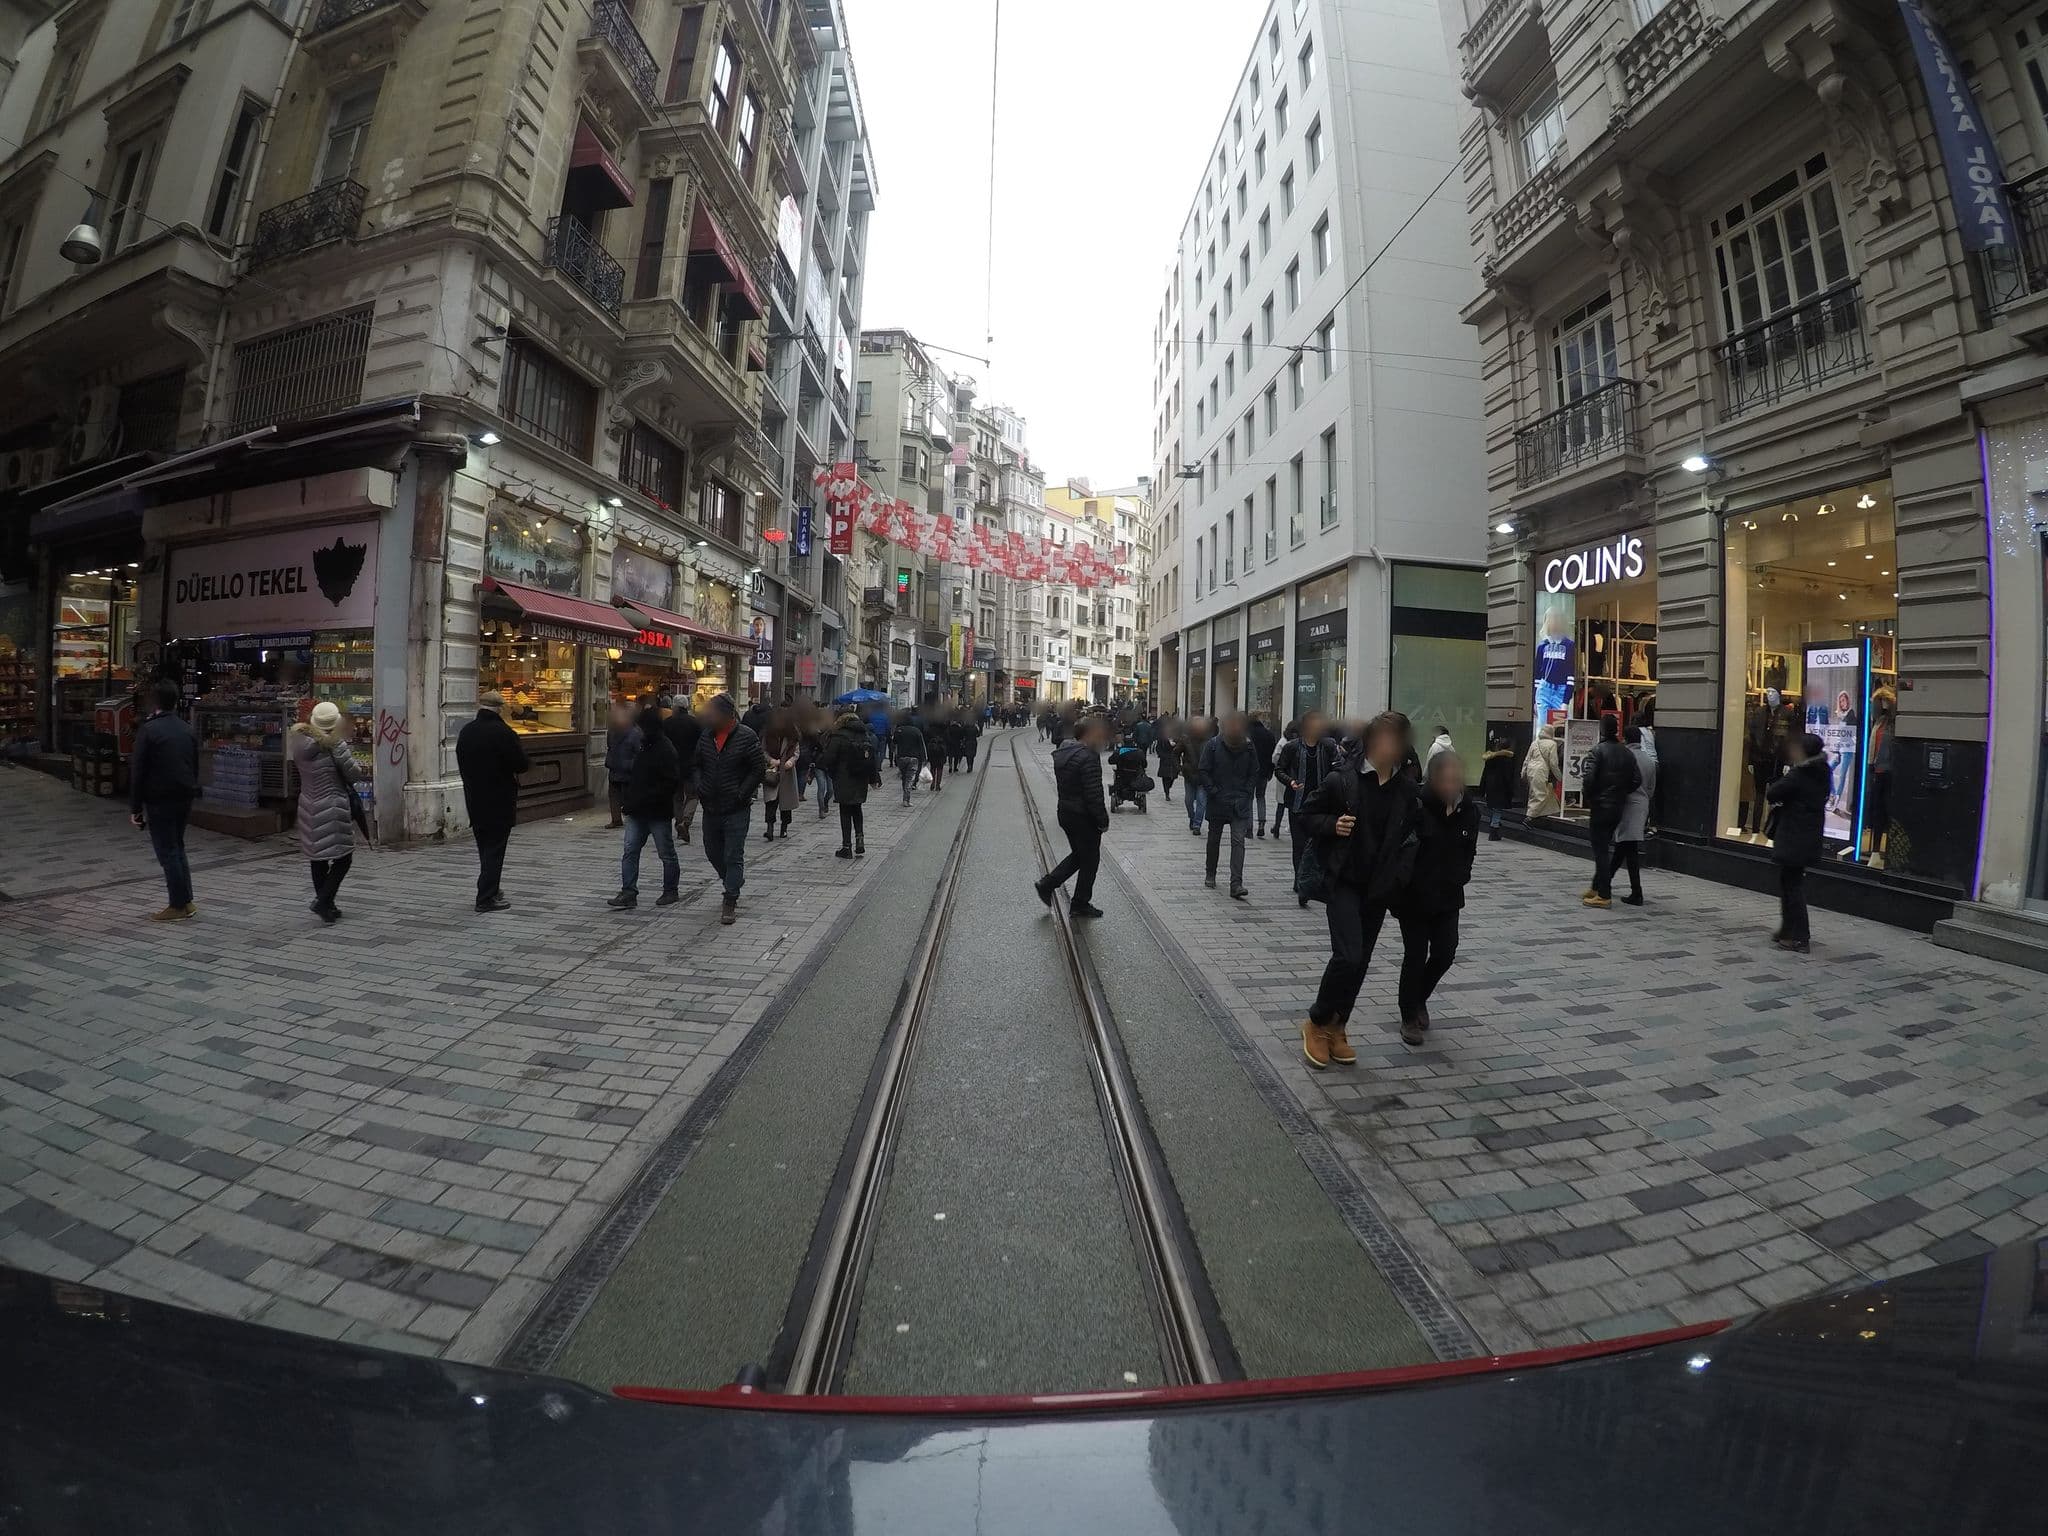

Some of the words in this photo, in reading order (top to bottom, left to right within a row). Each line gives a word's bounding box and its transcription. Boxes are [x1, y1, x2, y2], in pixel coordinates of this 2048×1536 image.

[1544, 534, 1644, 594] COLIN'S
[176, 573, 244, 604] DÜELLO
[247, 565, 308, 597] TEKEL
[531, 622, 573, 641] TURKISH
[576, 630, 629, 649] SPECIALITIES
[1310, 624, 1330, 637] ZARA
[634, 629, 673, 649] OSKA
[1257, 638, 1273, 649] ZARA
[1815, 653, 1850, 665] COLIN'S
[1827, 728, 1853, 738] SEZON
